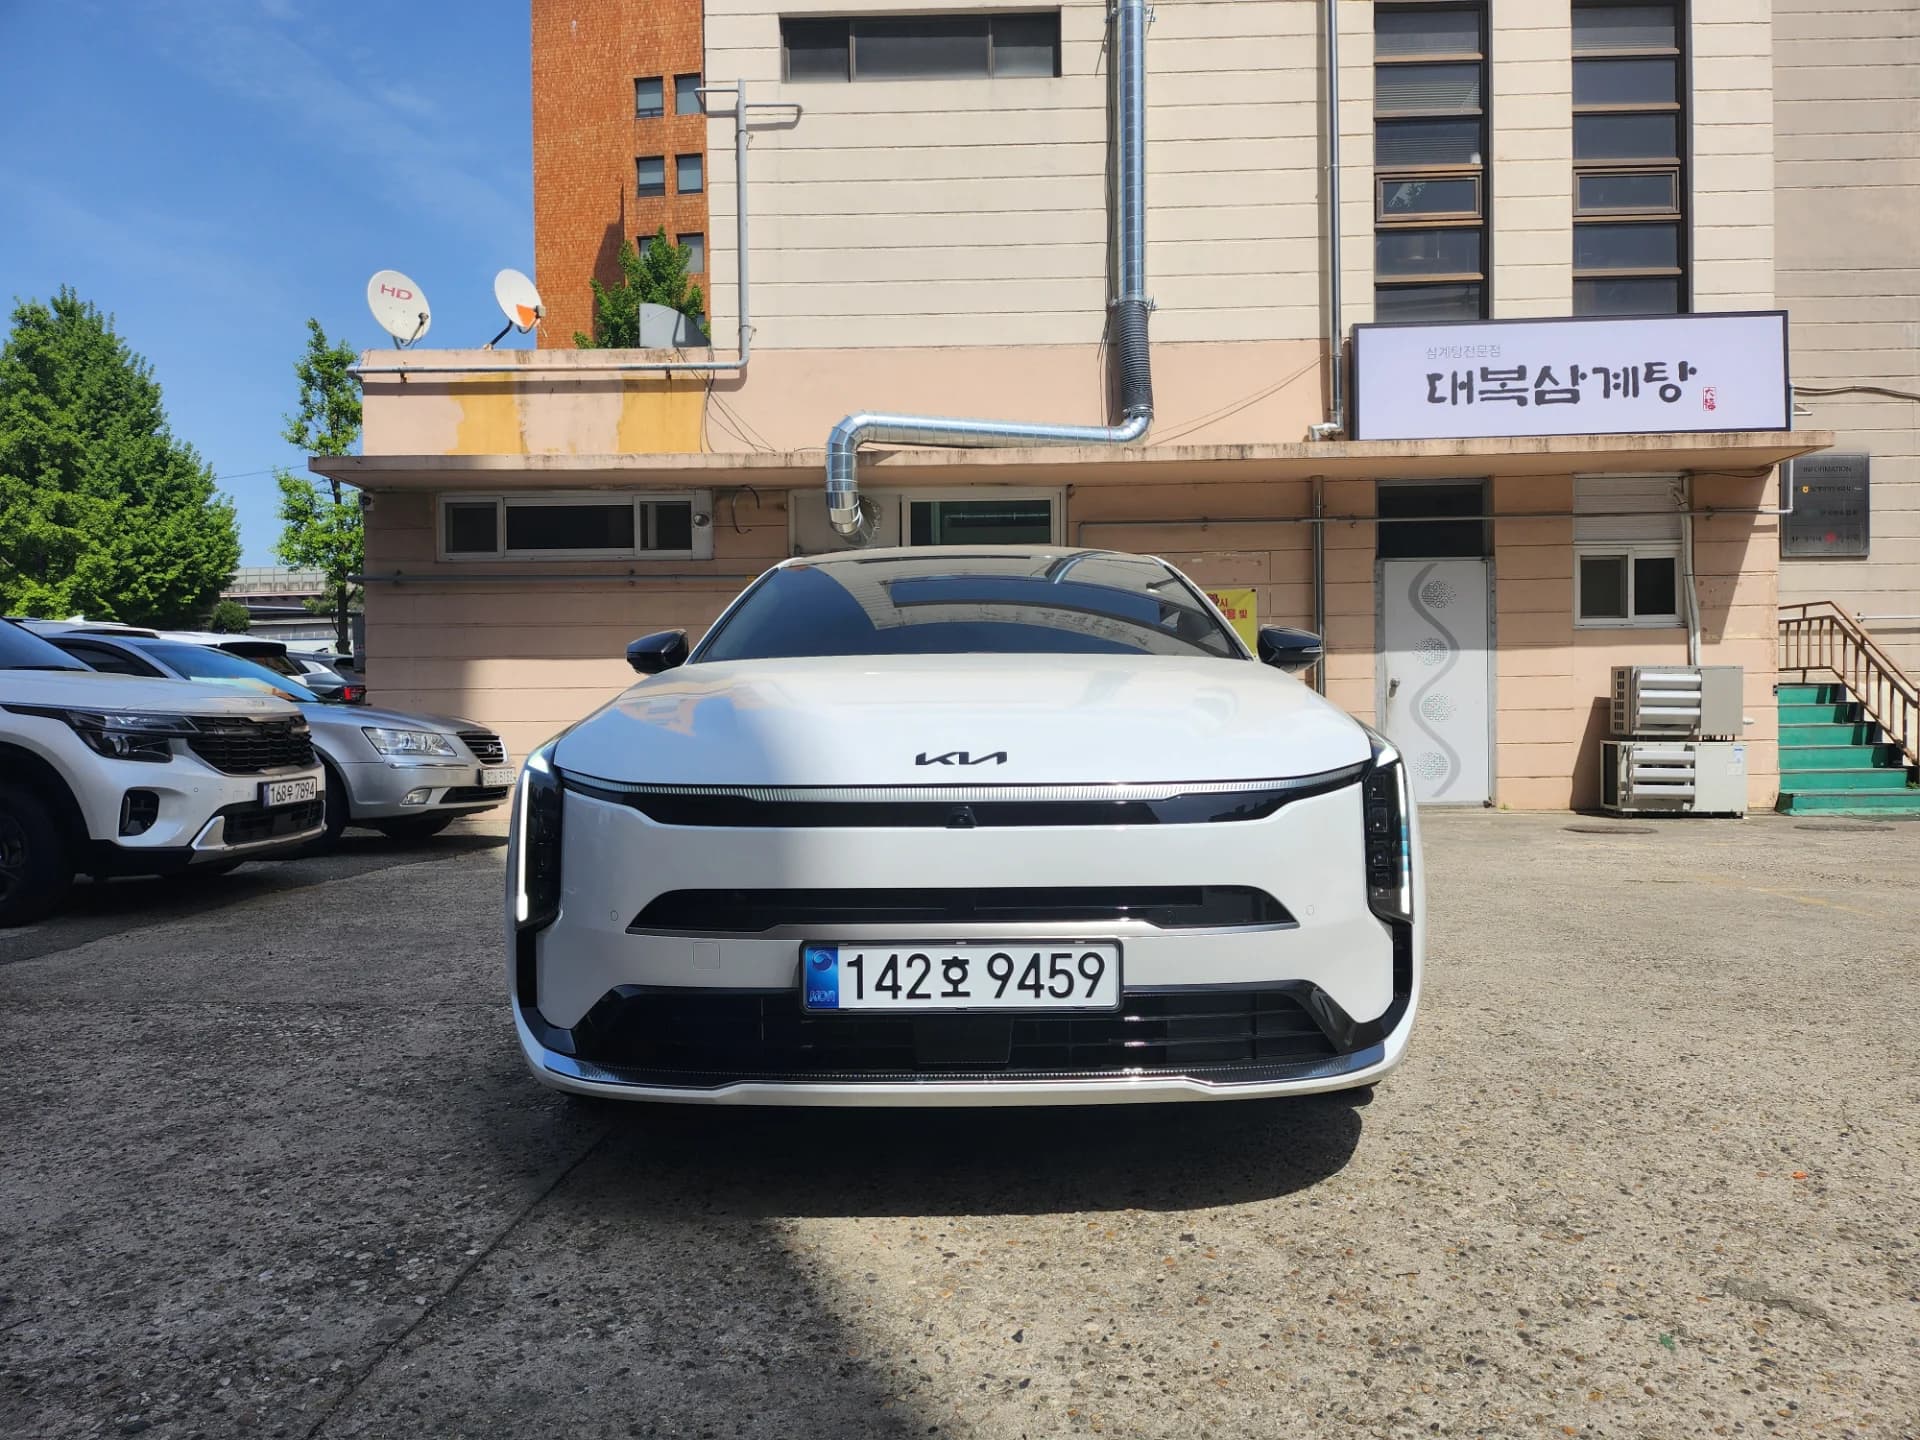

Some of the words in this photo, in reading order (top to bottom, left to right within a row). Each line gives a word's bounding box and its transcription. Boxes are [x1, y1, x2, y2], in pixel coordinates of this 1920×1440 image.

[380, 283, 413, 300] HD
[1426, 344, 1501, 360] 삼계탕전문점
[1426, 360, 1698, 407] 대복삼계탕
[915, 751, 1008, 766] KIA
[847, 953, 971, 1000] 142호
[987, 952, 1105, 998] 9459
